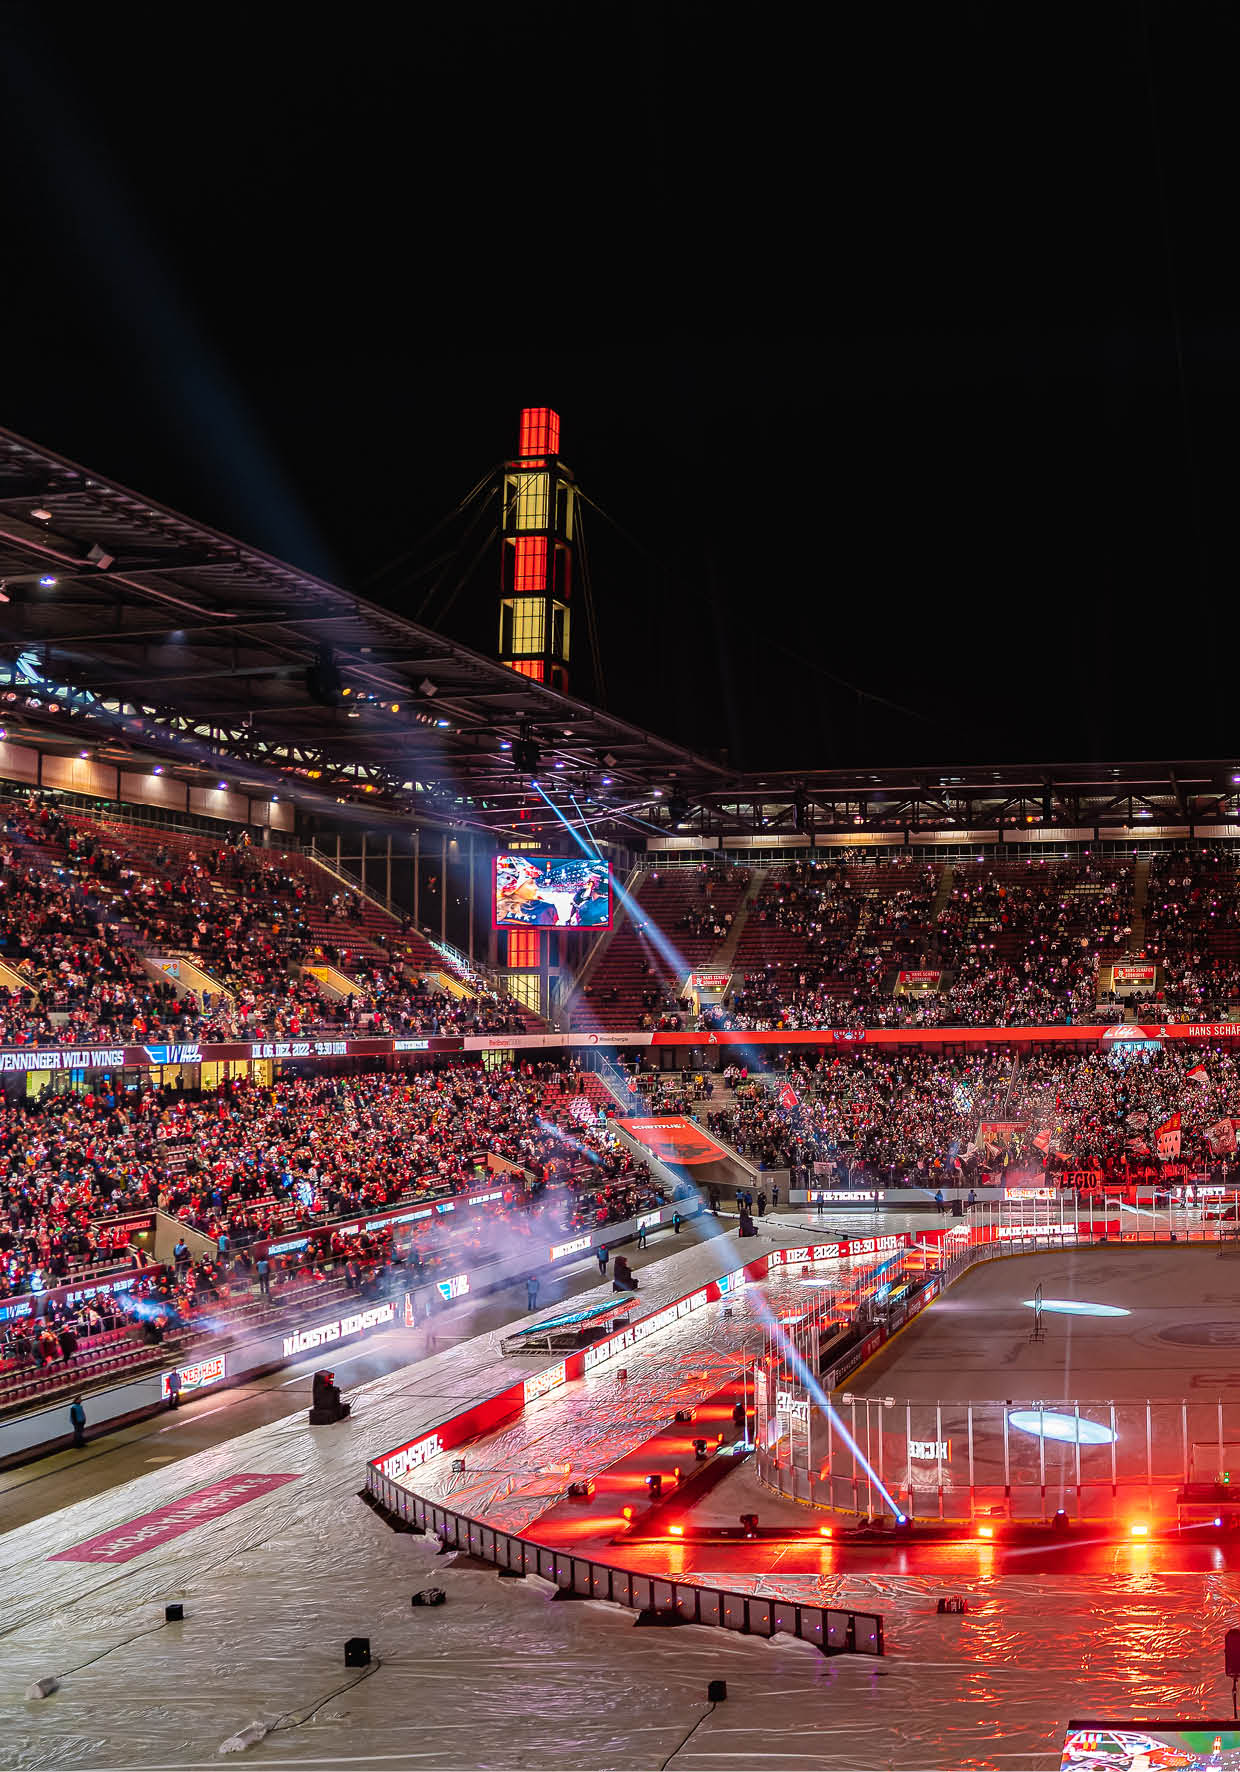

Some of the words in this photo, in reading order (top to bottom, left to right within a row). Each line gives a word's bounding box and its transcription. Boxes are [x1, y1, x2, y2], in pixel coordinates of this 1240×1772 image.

[1189, 1027, 1211, 1036] HANS
[62, 1051, 90, 1068] WILD
[90, 1050, 124, 1067] WINGS
[275, 1043, 291, 1057] DEZ.
[292, 1043, 310, 1057] 2022
[332, 1041, 348, 1055] UHR
[1060, 1172, 1097, 1189] LEGIO
[786, 1250, 812, 1265] DEZ.
[813, 1247, 839, 1261] 2022
[848, 1241, 875, 1255] 19:30
[876, 1235, 897, 1250] UHR
[283, 1321, 340, 1358] NÄCHSTES
[200, 1359, 223, 1381] HAIE
[384, 1433, 444, 1478] HEIMSPIEL:
[163, 1485, 251, 1527] MAGENTA
[91, 1525, 170, 1557] SPORT
